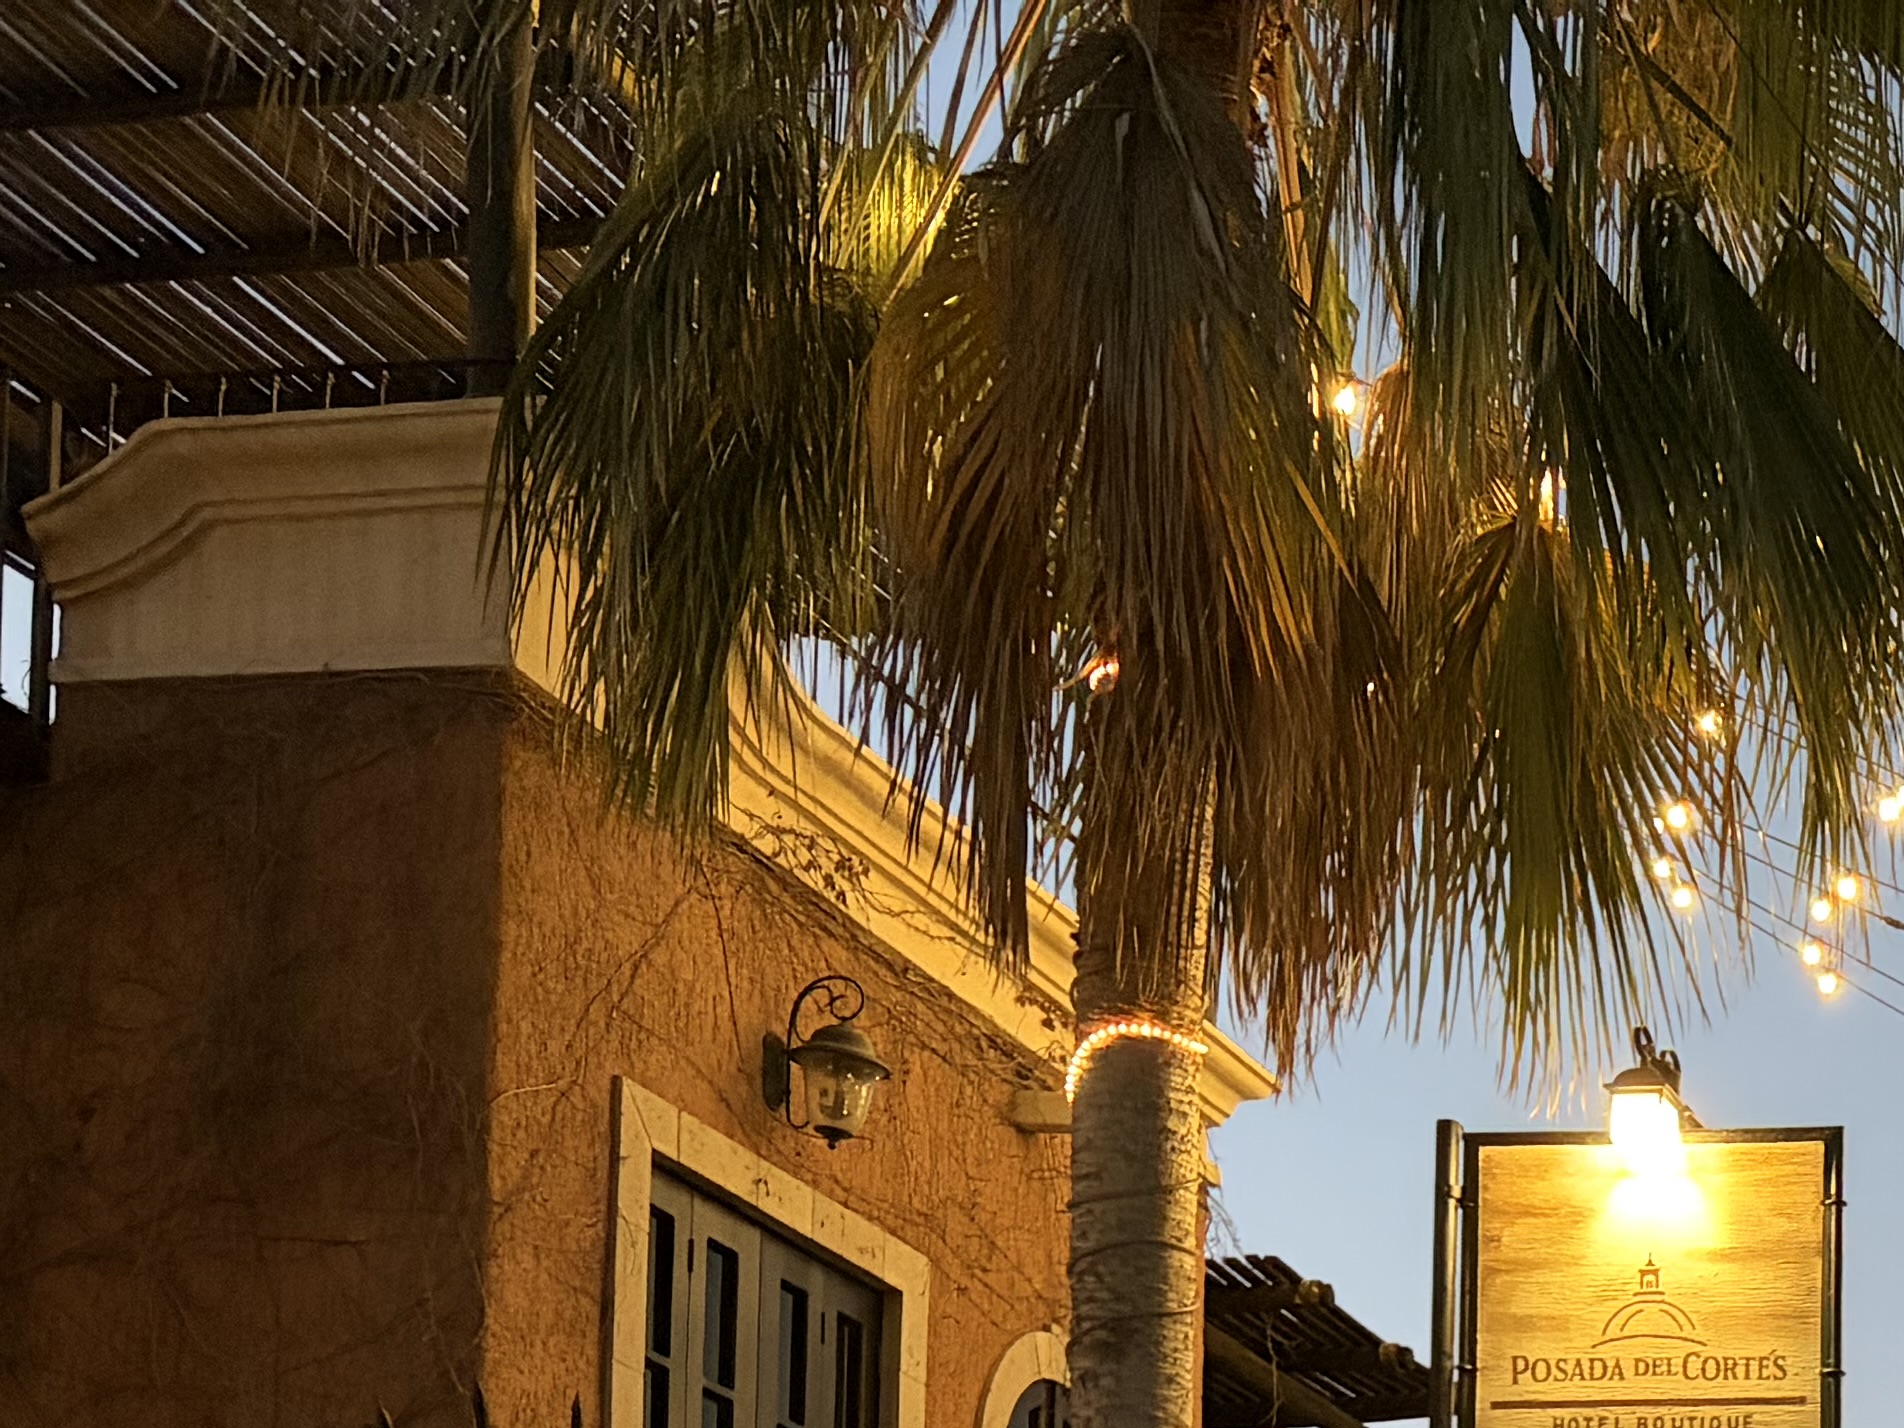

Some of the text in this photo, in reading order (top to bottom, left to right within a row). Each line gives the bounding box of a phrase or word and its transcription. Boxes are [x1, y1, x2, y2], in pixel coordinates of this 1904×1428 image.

[1511, 1349, 1788, 1385] POSADA DEL CORTÉS
